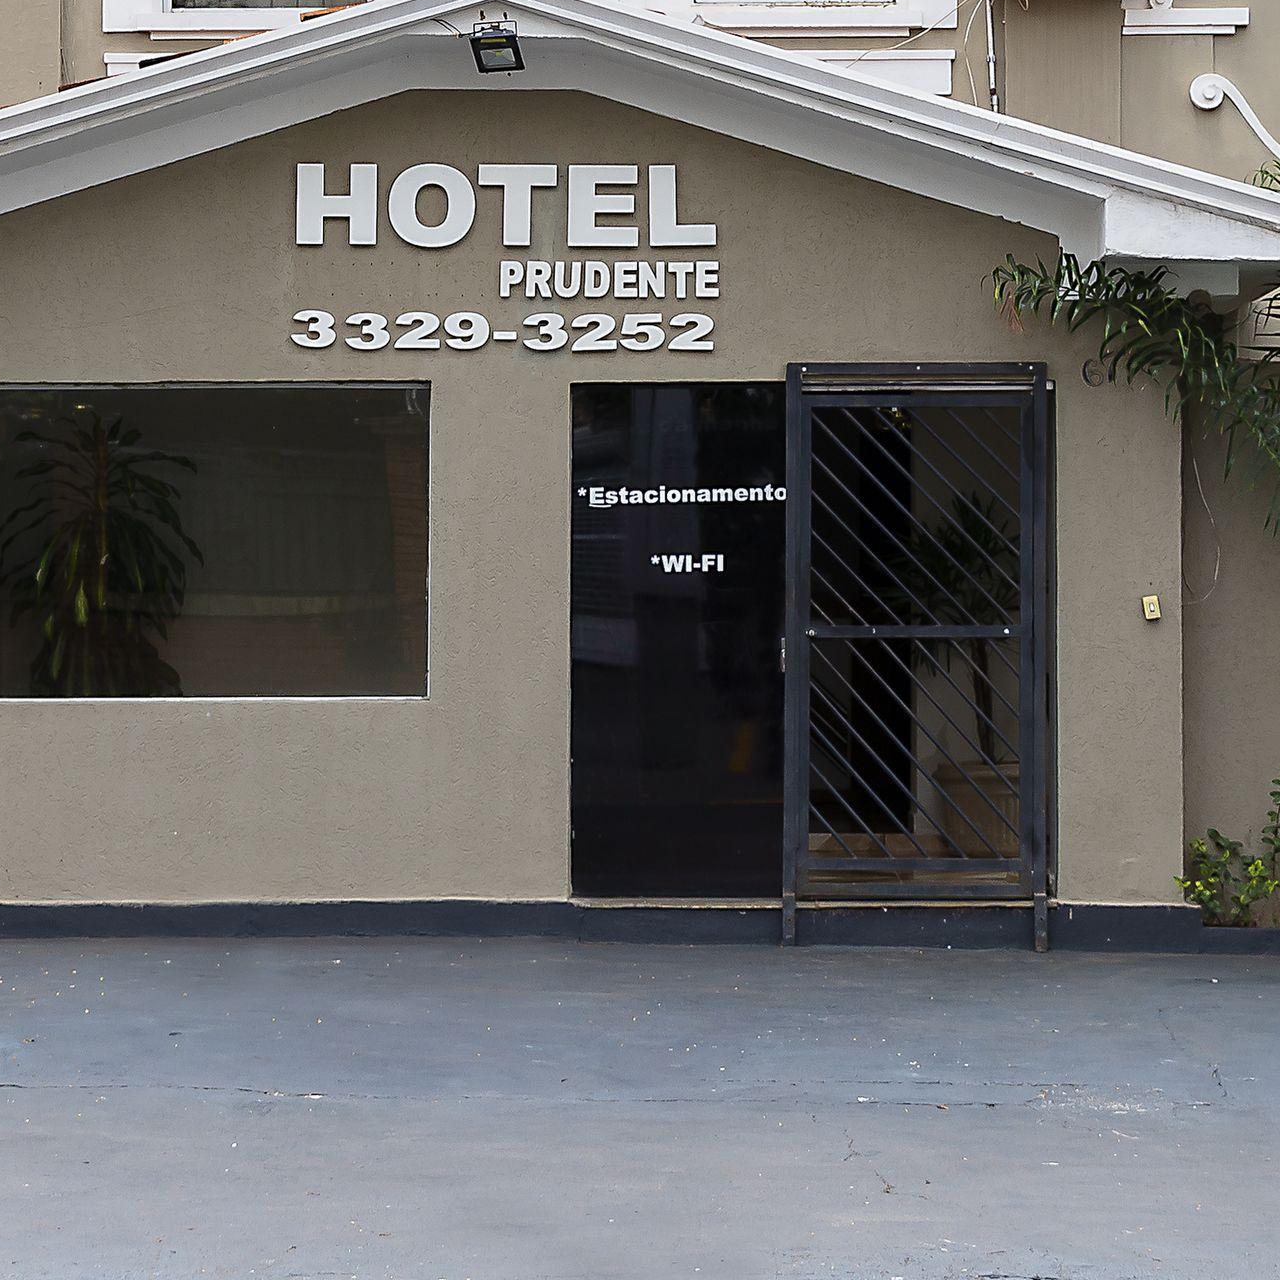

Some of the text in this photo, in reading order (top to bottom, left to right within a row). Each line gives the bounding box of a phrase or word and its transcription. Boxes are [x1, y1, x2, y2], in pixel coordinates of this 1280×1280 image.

[295, 162, 717, 248] HOTEL
[499, 260, 721, 298] PRUDENTE
[289, 308, 716, 352] 3329-3252
